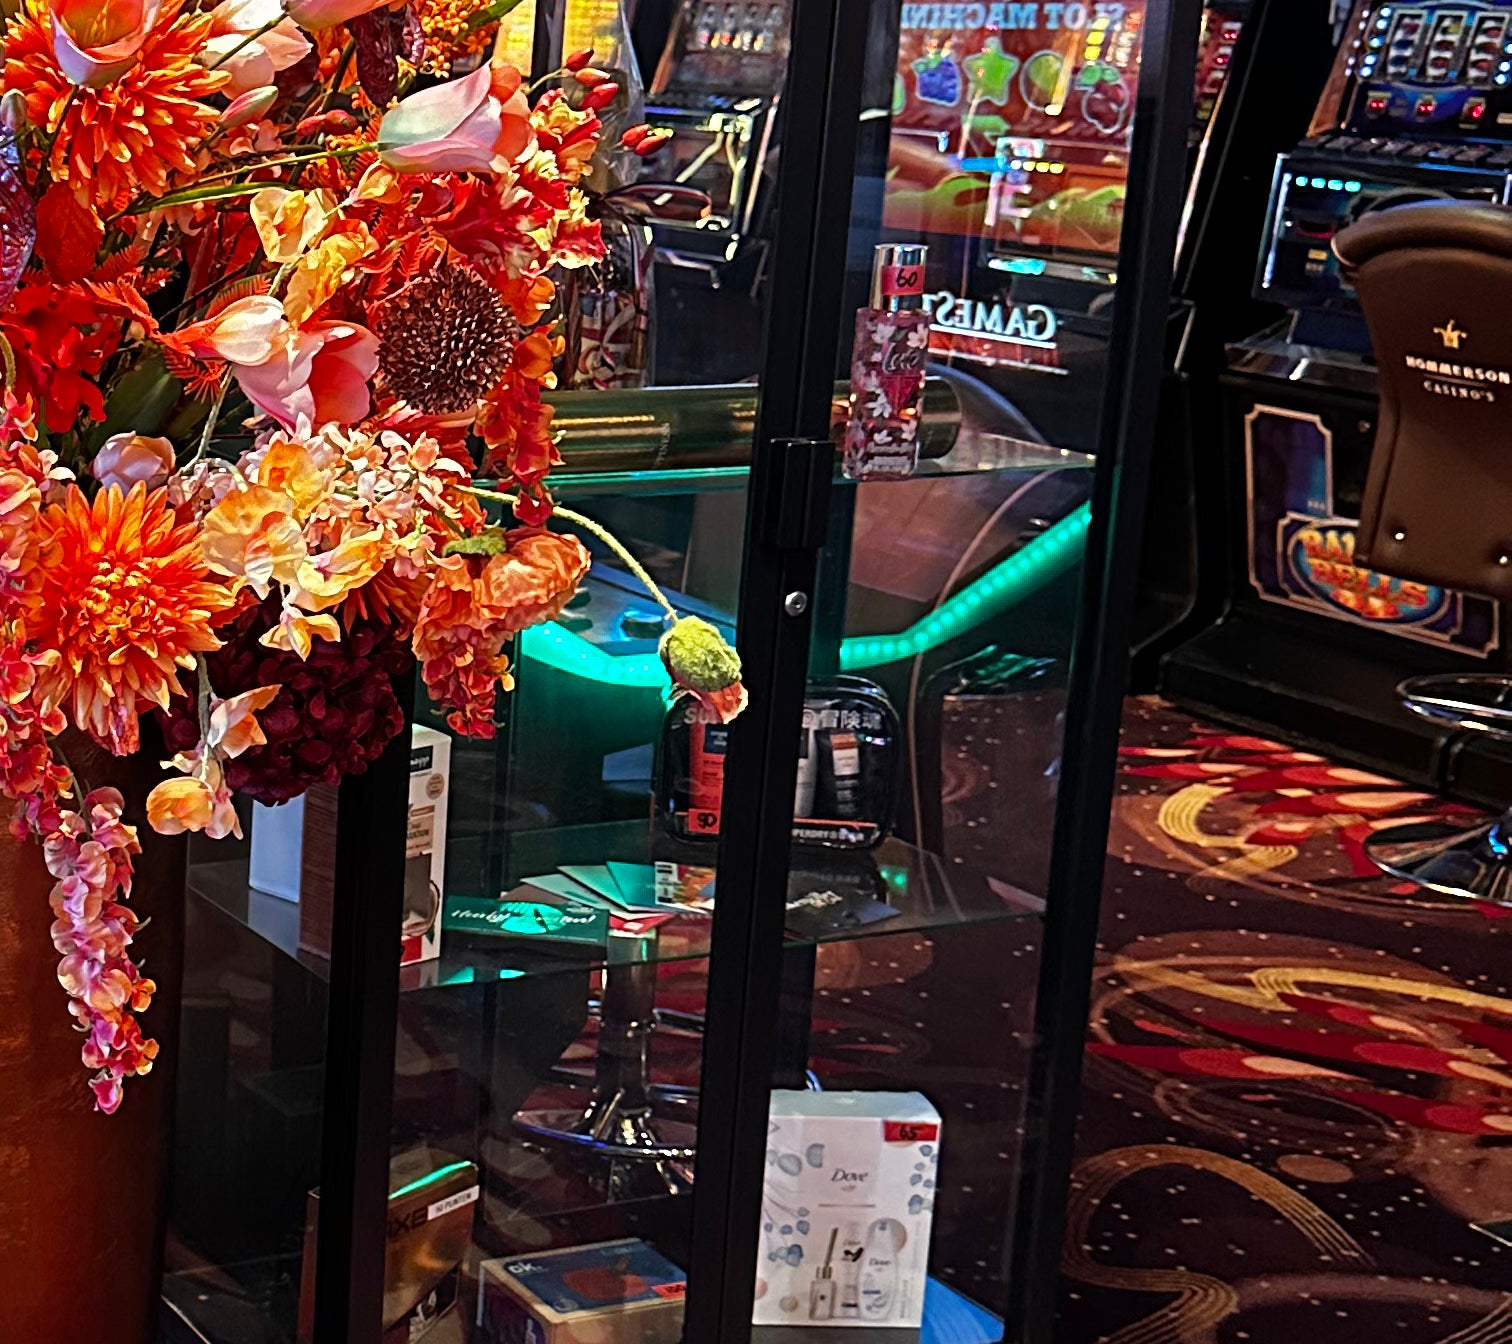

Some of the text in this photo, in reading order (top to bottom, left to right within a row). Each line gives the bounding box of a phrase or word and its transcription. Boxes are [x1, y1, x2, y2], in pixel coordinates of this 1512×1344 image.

[895, 269, 918, 288] 60
[1405, 355, 1510, 385] HOMMERSON
[831, 1168, 868, 1183] Dove
